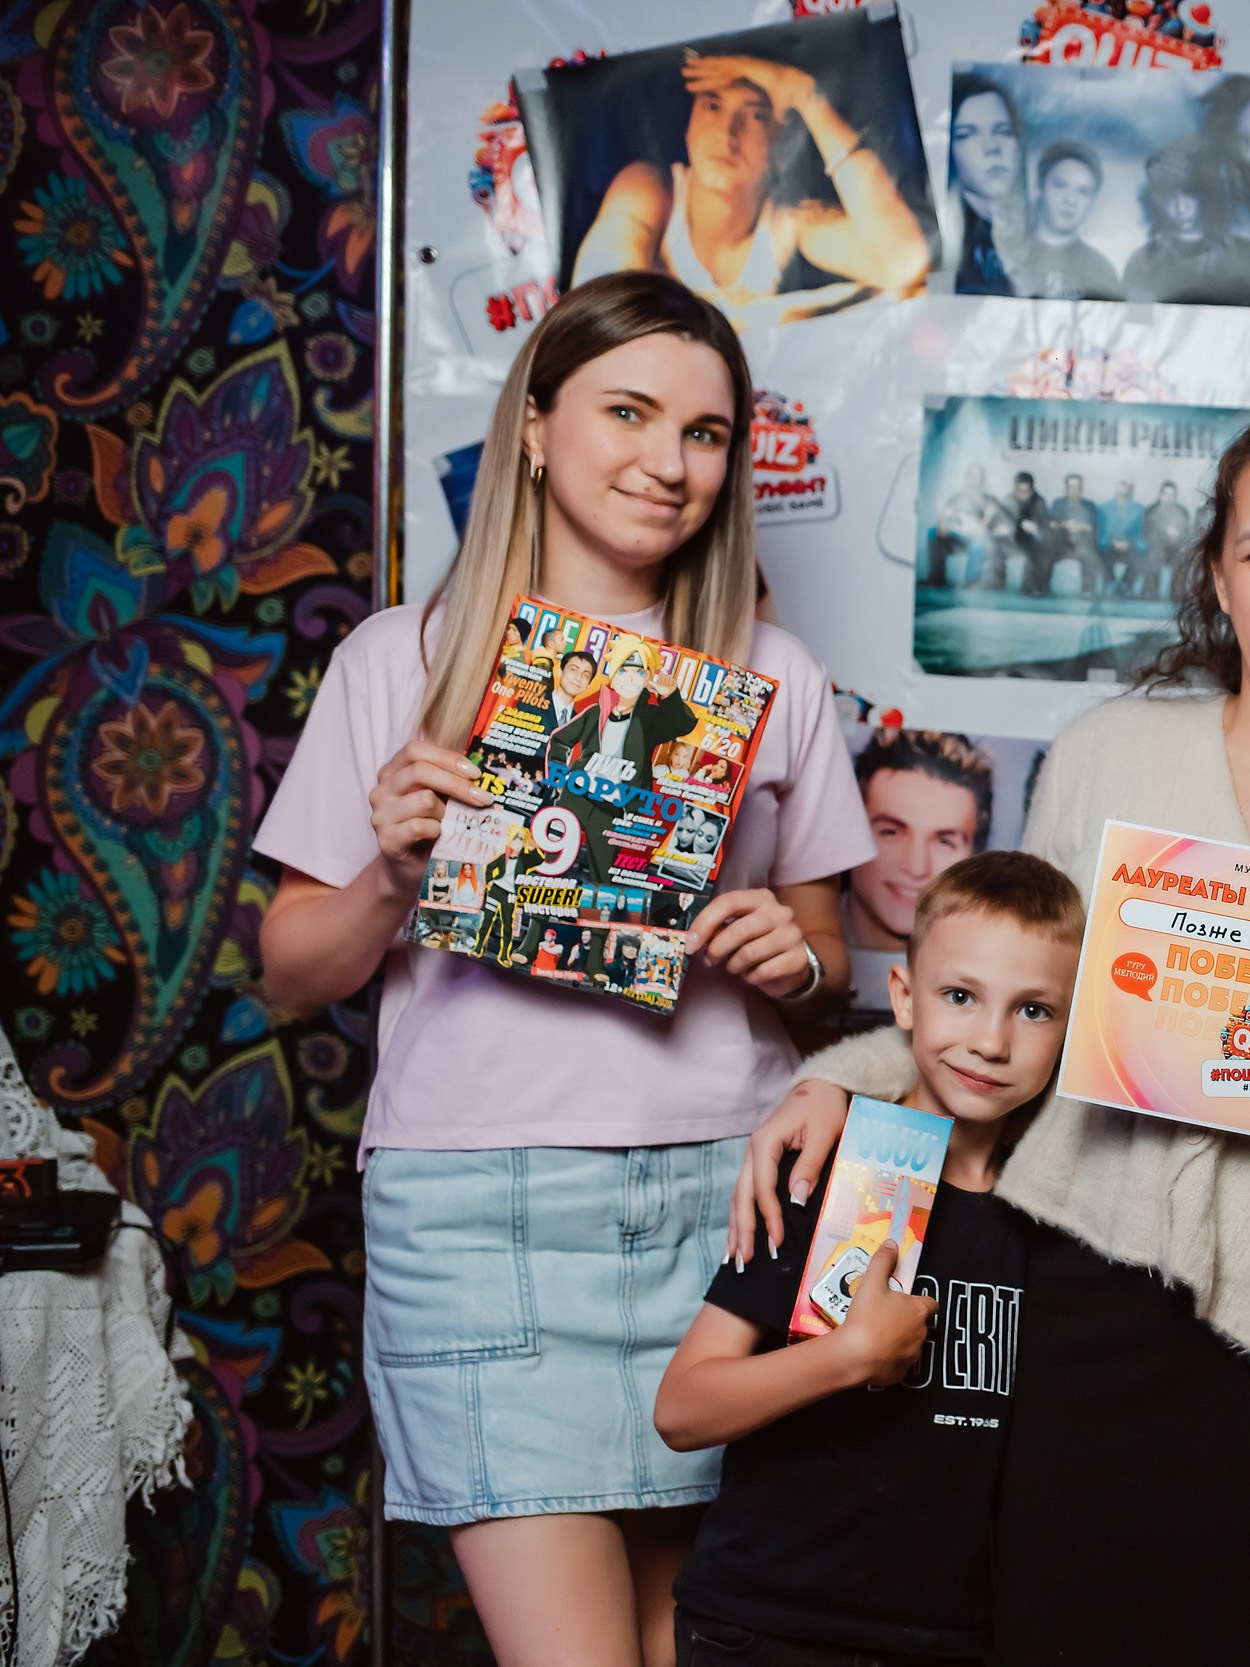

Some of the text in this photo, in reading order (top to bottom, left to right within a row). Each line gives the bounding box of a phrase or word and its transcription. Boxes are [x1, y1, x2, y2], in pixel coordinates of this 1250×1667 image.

[1010, 414, 1218, 459] LINKIN PARK
[491, 680, 551, 710] One Pilots
[505, 671, 547, 696] Twenty
[701, 733, 741, 759] 6/20
[472, 771, 507, 796] TS
[542, 760, 684, 822] БОРУТО
[530, 806, 582, 877] 9
[517, 887, 583, 906] SUPER!
[1112, 863, 1247, 905] ЛАУРЕАТЫ
[1171, 912, 1242, 943] Позже
[1114, 967, 1155, 982] МЕЛОДИЙ
[1126, 960, 1146, 969] ГУРУ
[933, 1414, 968, 1426] EST.
